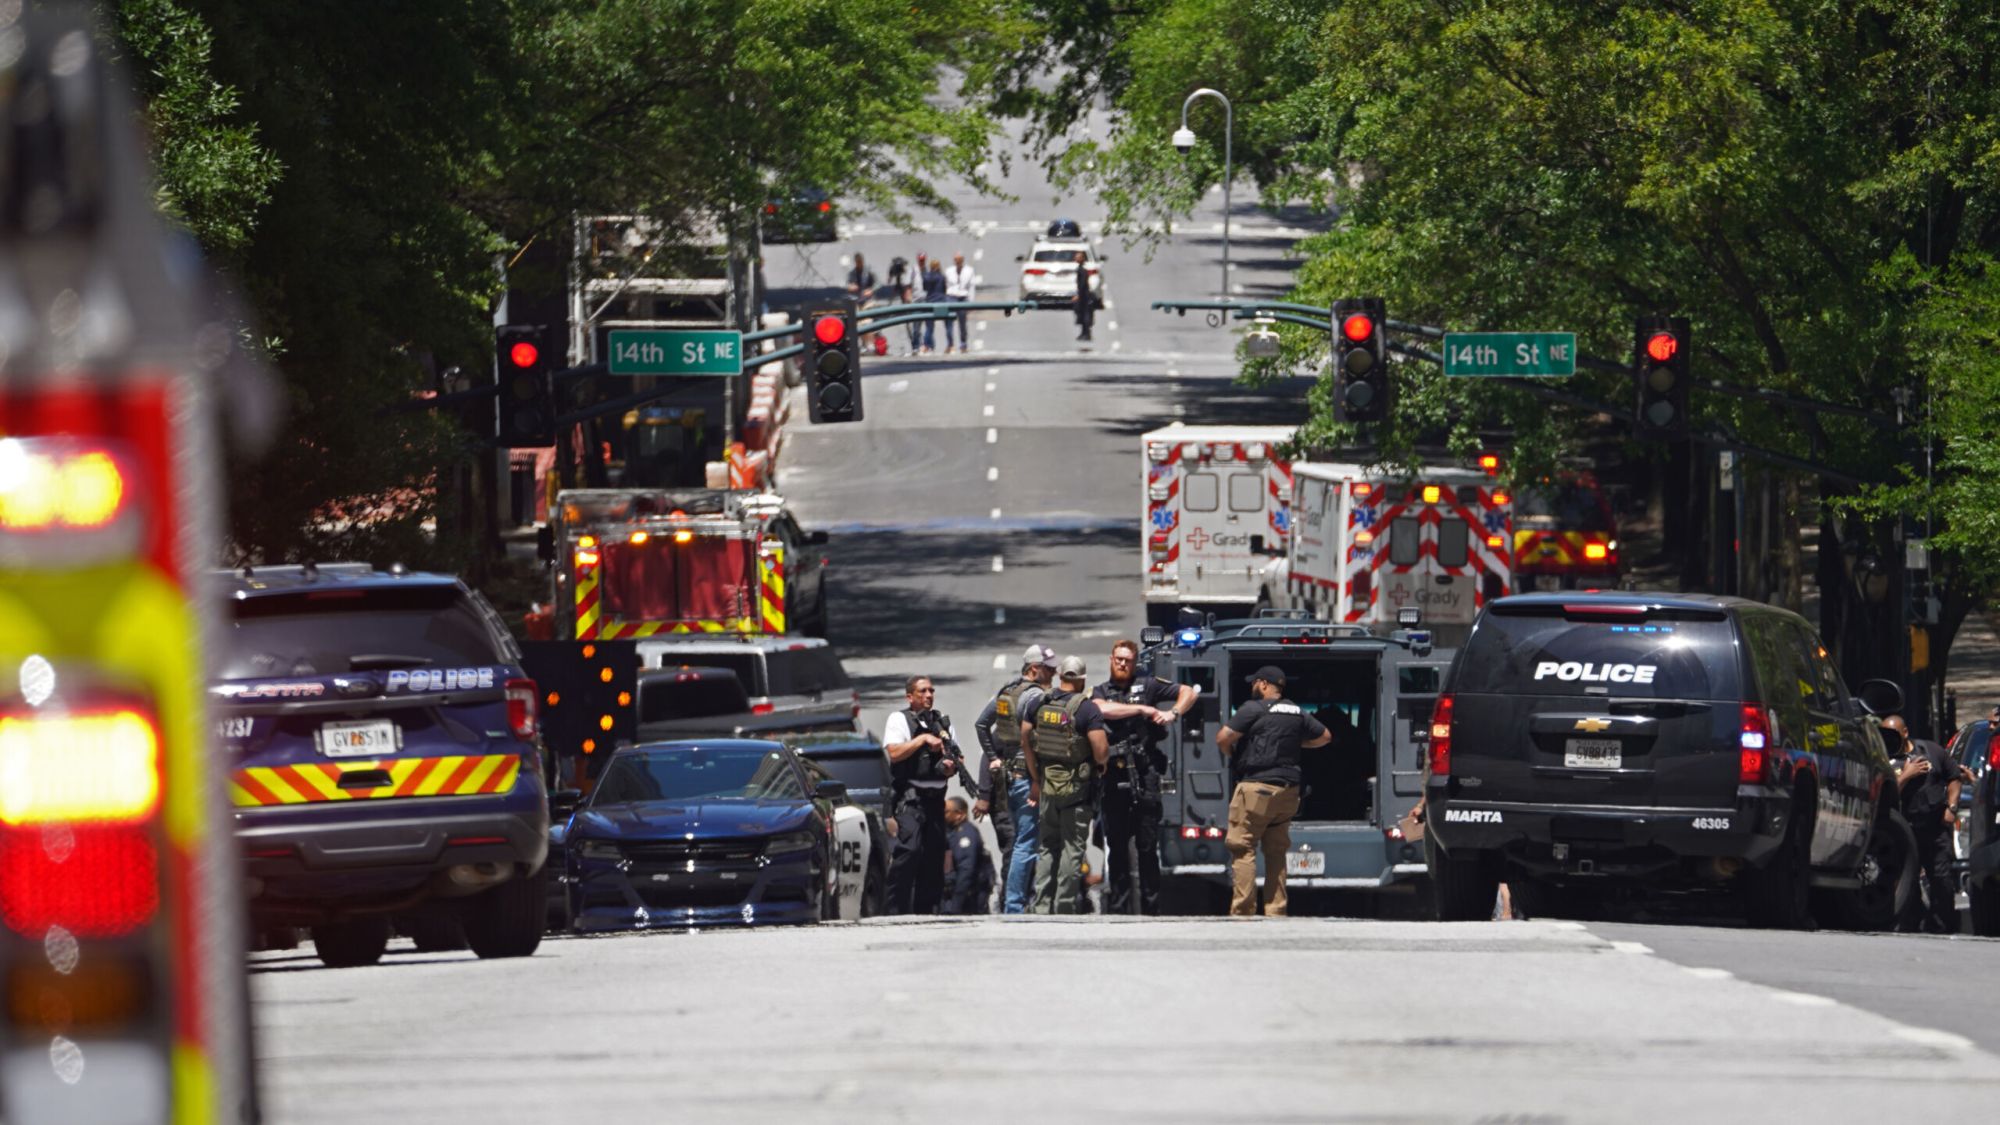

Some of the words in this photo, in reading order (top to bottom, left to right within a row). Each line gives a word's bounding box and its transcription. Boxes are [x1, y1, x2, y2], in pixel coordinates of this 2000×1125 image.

[616, 342, 664, 363] 14th
[682, 342, 706, 364] St
[714, 342, 735, 359] NE
[1450, 344, 1498, 366] 14th
[1516, 343, 1540, 365] St
[1550, 344, 1569, 361] NE
[1212, 531, 1248, 546] Grad
[1415, 588, 1460, 607] Grady
[387, 667, 494, 692] POLICE
[1534, 661, 1658, 684] POLICE
[1043, 711, 1061, 723] FBI
[1445, 810, 1503, 823] MARTA
[1692, 817, 1730, 829] 46305
